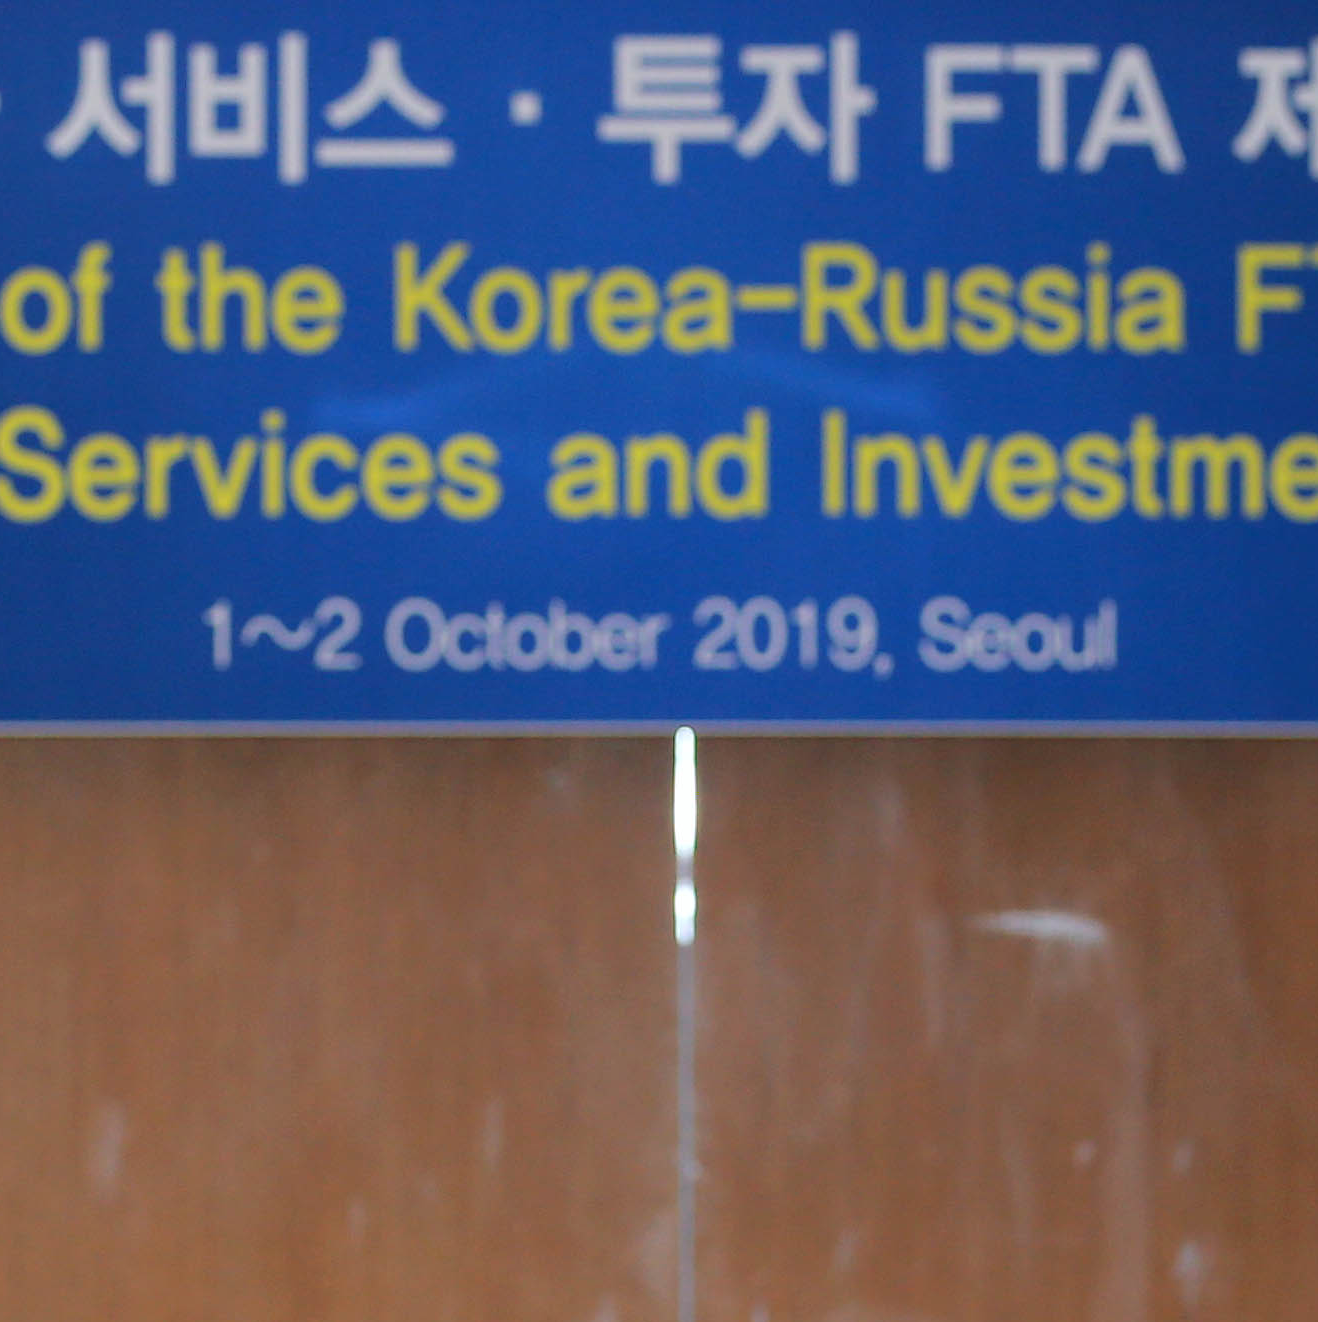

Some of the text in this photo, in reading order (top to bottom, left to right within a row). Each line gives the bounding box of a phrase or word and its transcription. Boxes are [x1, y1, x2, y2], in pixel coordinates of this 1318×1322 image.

[48, 32, 455, 185] 서비스
[598, 32, 877, 184] 투자
[926, 44, 1183, 172] FTA
[156, 242, 344, 354] the
[394, 242, 1185, 354] Korea-Russia
[546, 407, 770, 520] and
[385, 597, 668, 671] October
[694, 597, 893, 676] 2019,
[920, 597, 1117, 671] Seoul
